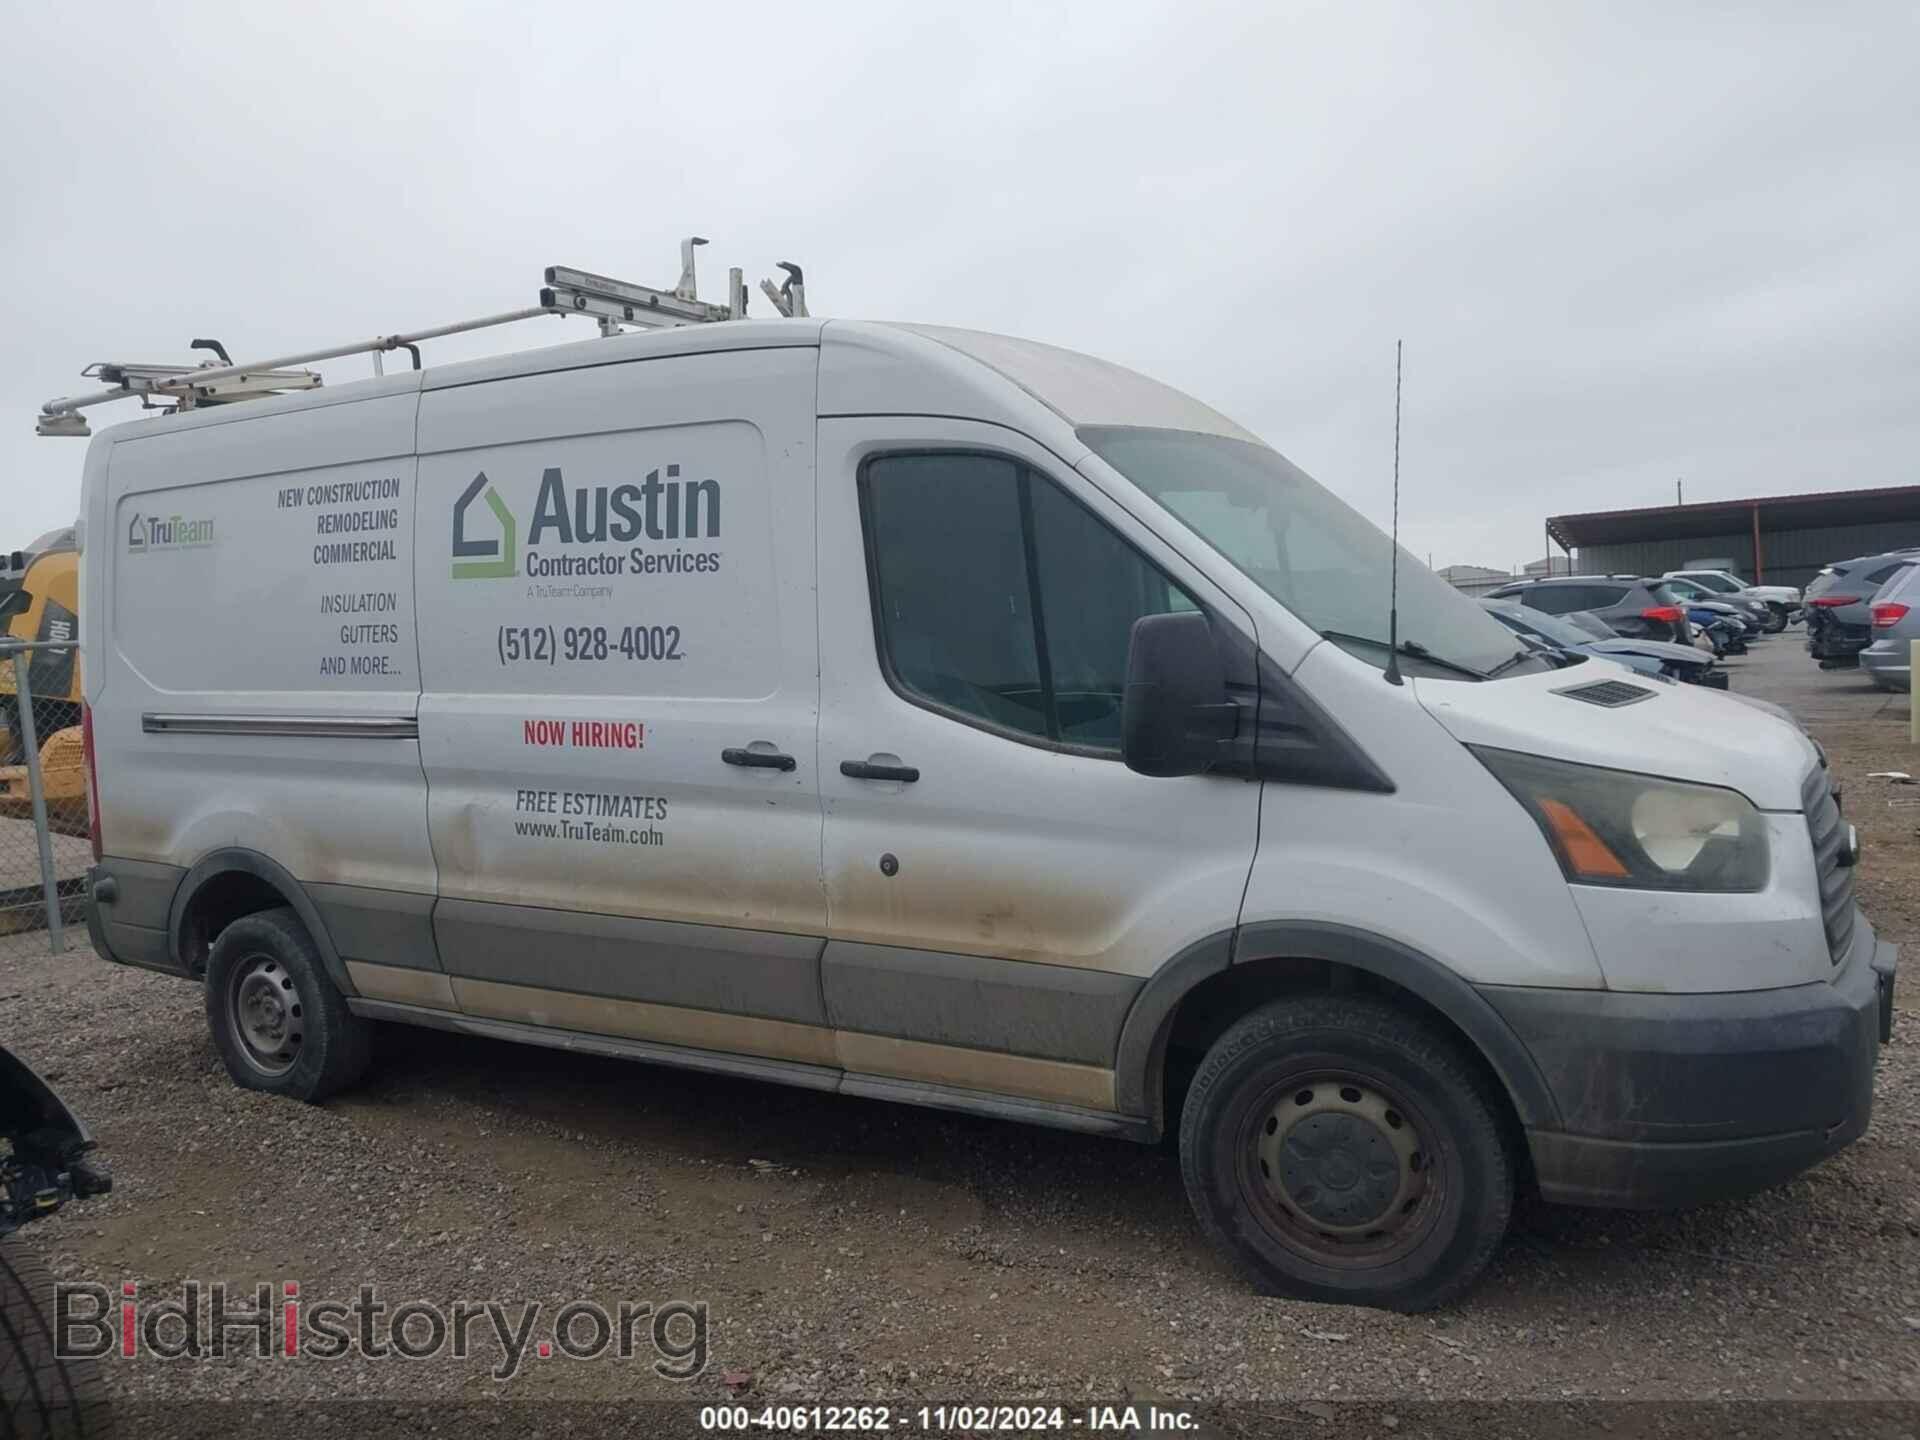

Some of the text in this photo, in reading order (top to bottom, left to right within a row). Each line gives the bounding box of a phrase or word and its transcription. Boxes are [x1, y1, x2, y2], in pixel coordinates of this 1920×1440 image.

[278, 478, 401, 508] NEW CONSTRUCTION
[527, 464, 721, 545] Austin
[147, 516, 213, 544] TruTeam
[317, 509, 399, 534] REMODELING
[313, 540, 397, 564] COMMERCIAL
[526, 547, 720, 577] Contractor Services
[320, 593, 397, 613] INSULATION
[340, 624, 399, 644] GUTTERS
[498, 625, 682, 665] (512) 928-4002
[319, 656, 401, 675] AND MORE...
[524, 720, 644, 749] NOW HIRING!
[516, 790, 668, 821] FREE ESTIMATES
[514, 820, 664, 846] www.TruTeam.com
